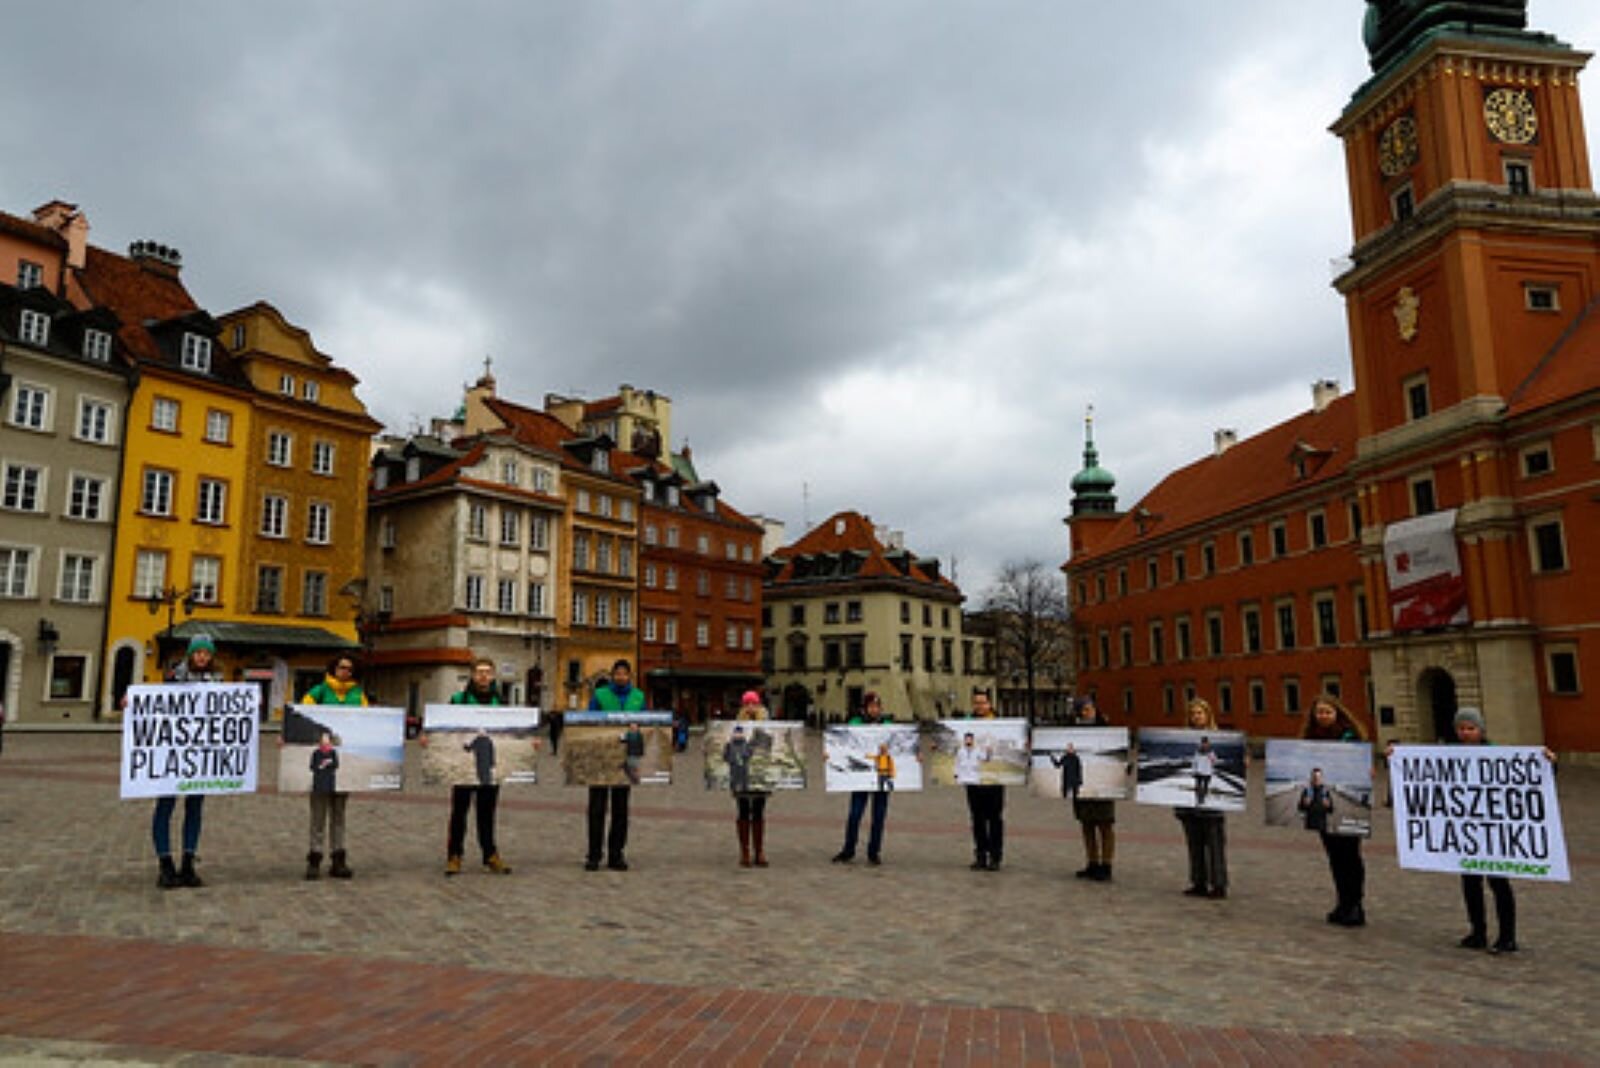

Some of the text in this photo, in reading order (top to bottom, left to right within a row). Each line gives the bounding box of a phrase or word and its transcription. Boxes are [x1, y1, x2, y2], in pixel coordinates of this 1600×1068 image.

[133, 688, 253, 715] MAMY DOŚĆ
[133, 717, 253, 746] WASZEGO
[130, 747, 249, 781] PLASTIKU
[1402, 752, 1542, 785] MAMY DOŚĆ
[1404, 785, 1546, 821] WASZEGO
[1408, 819, 1549, 859] PLASTIKU
